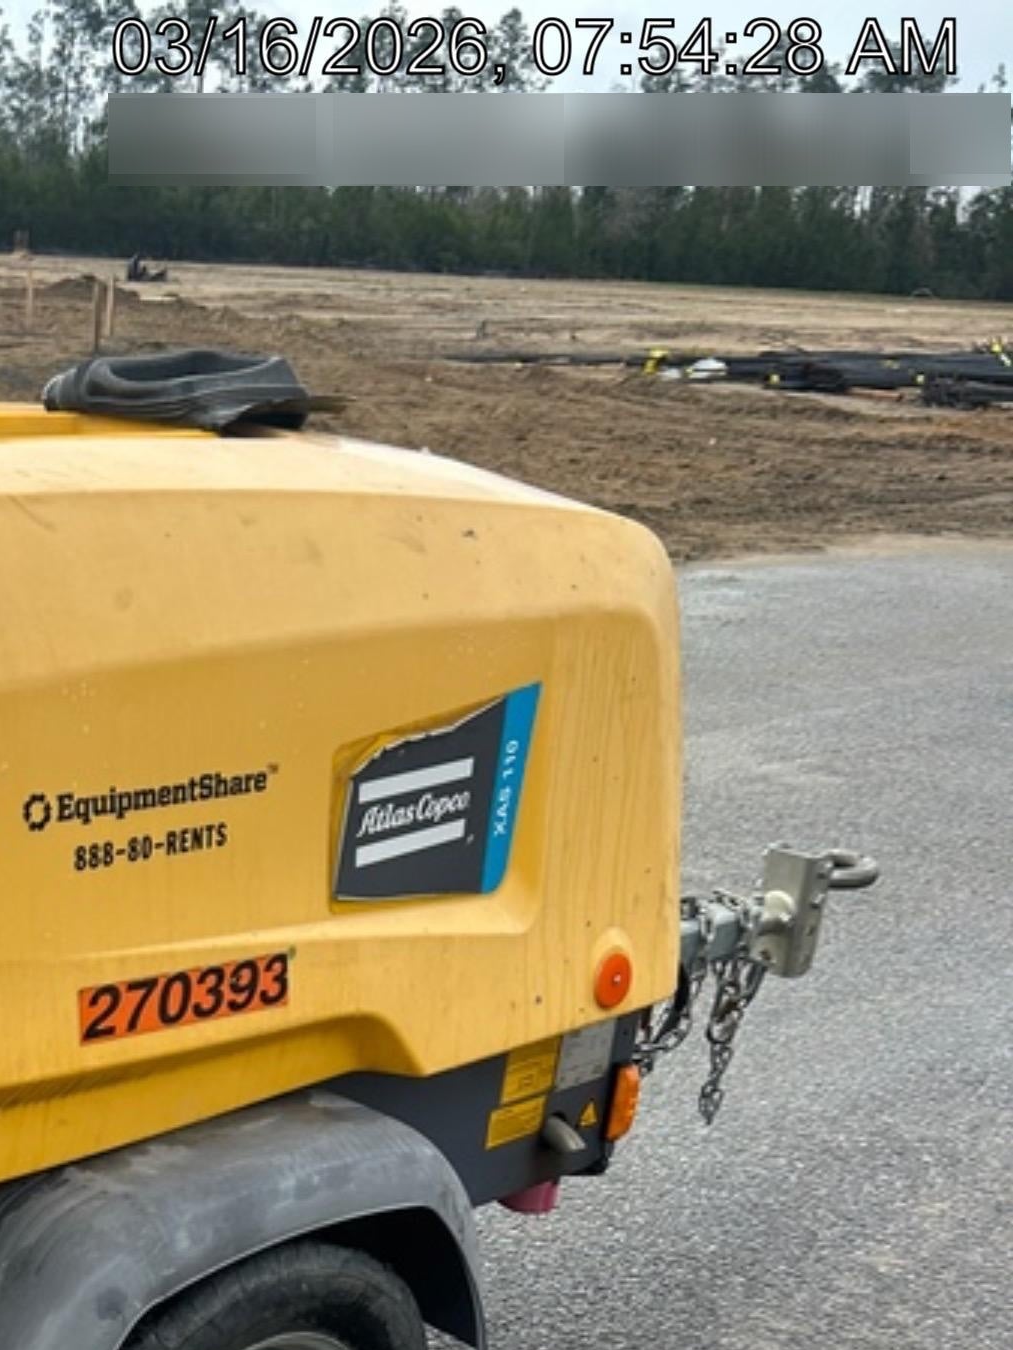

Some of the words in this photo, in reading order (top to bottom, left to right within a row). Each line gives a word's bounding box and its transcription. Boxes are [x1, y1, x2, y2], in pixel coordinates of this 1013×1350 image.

[355, 801, 416, 838] Atlas
[415, 790, 471, 824] Copco
[73, 821, 229, 872] 888-80-RENTS
[83, 952, 289, 1042] 270393
